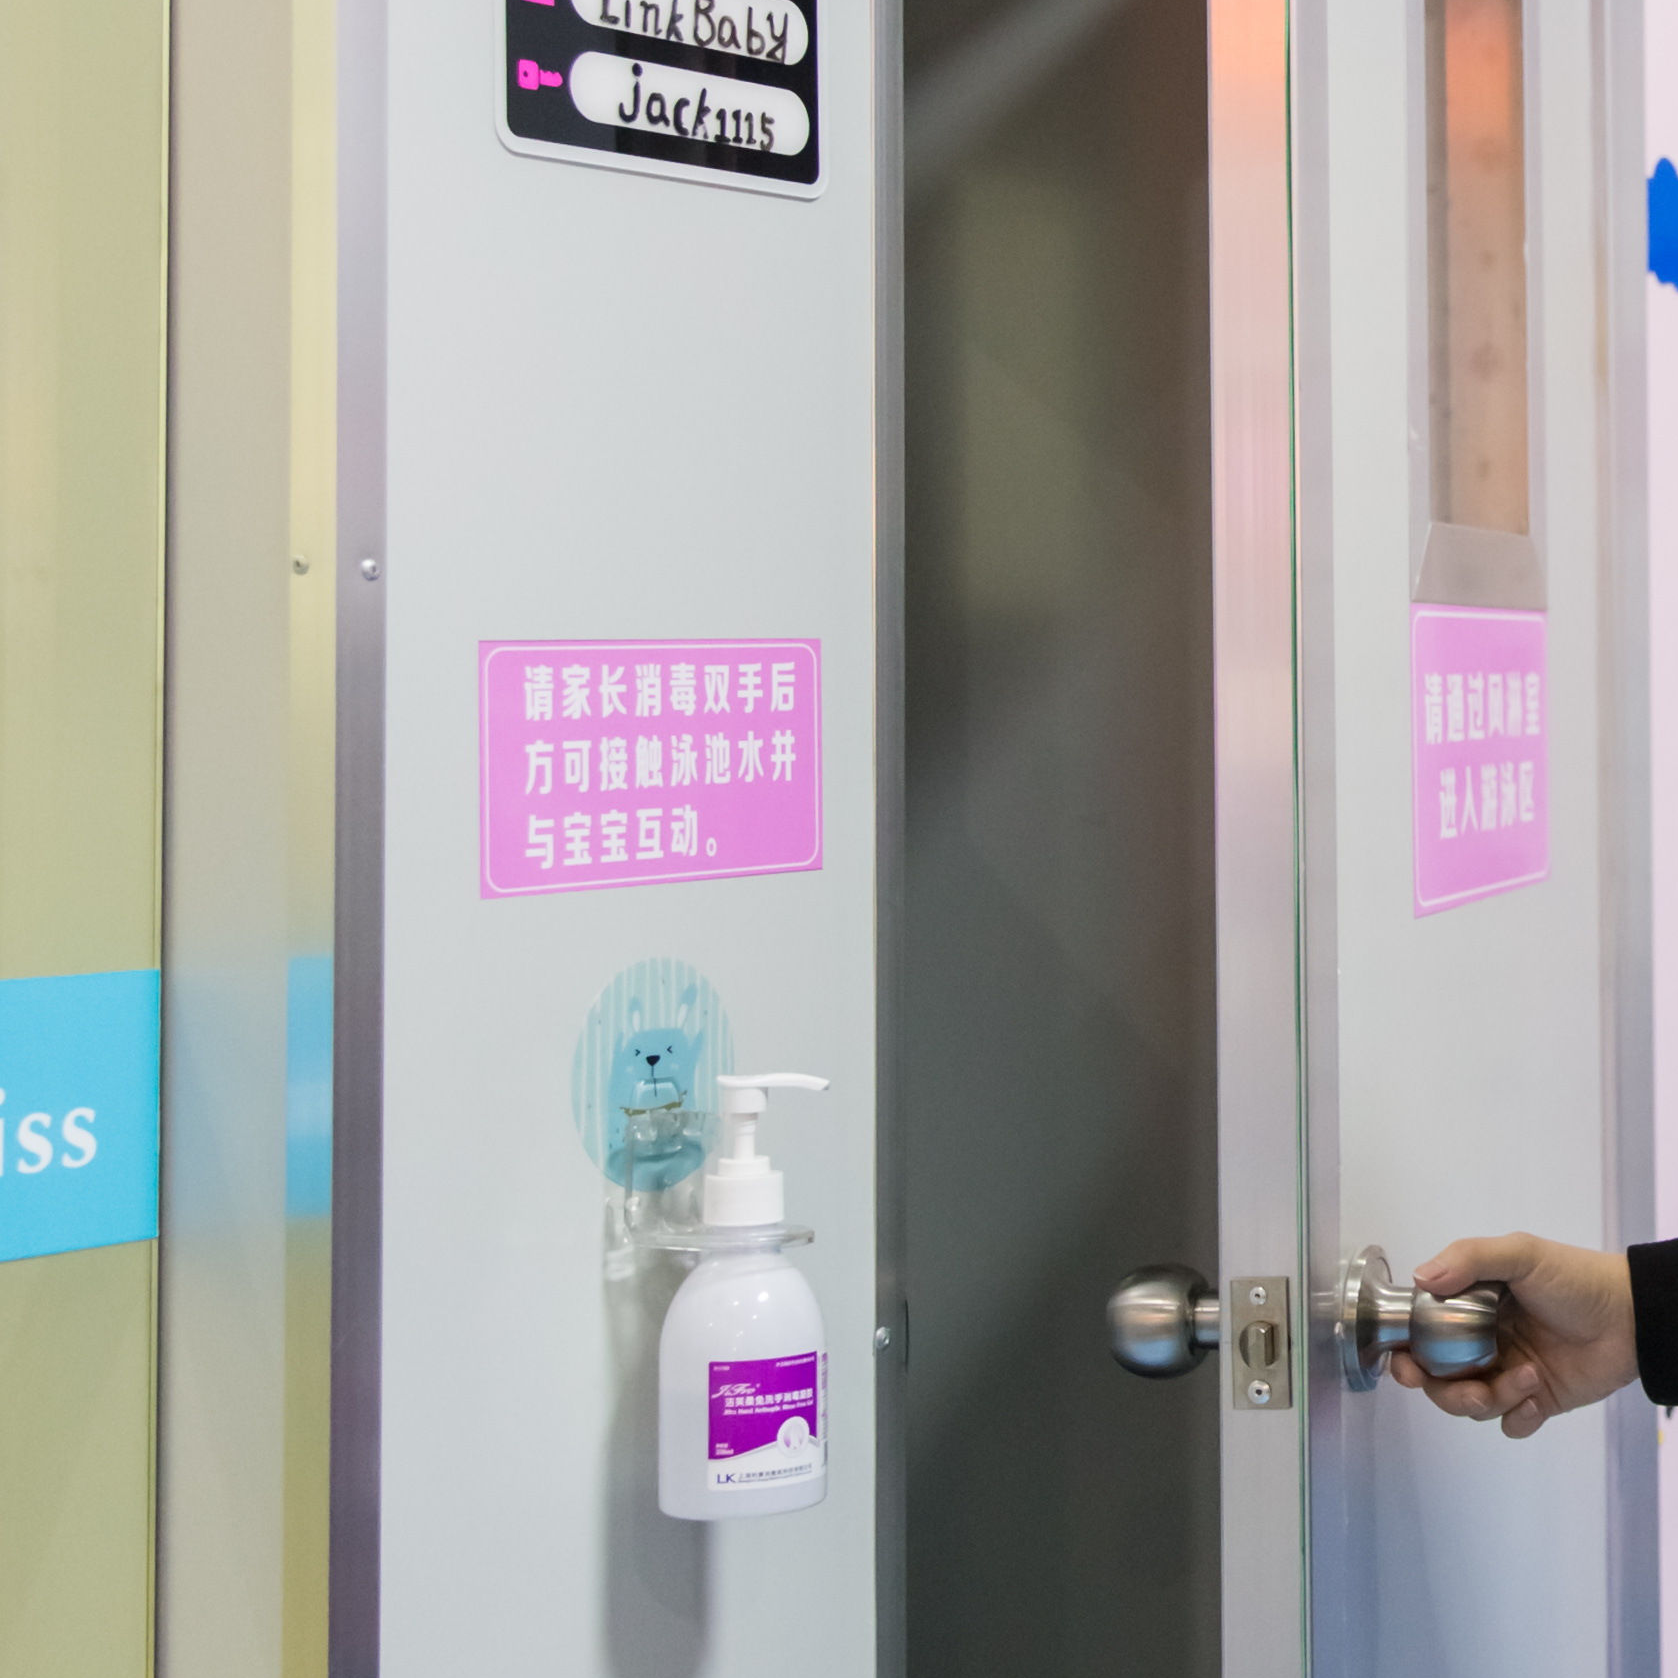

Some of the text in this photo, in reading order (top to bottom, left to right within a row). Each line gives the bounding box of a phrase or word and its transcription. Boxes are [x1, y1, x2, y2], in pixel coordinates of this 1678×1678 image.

[618, 62, 776, 153] jack1115
[524, 661, 796, 722] 请家长消毒双手后
[524, 804, 717, 870] 与宝宝互动。
[717, 1473, 737, 1484] LK
